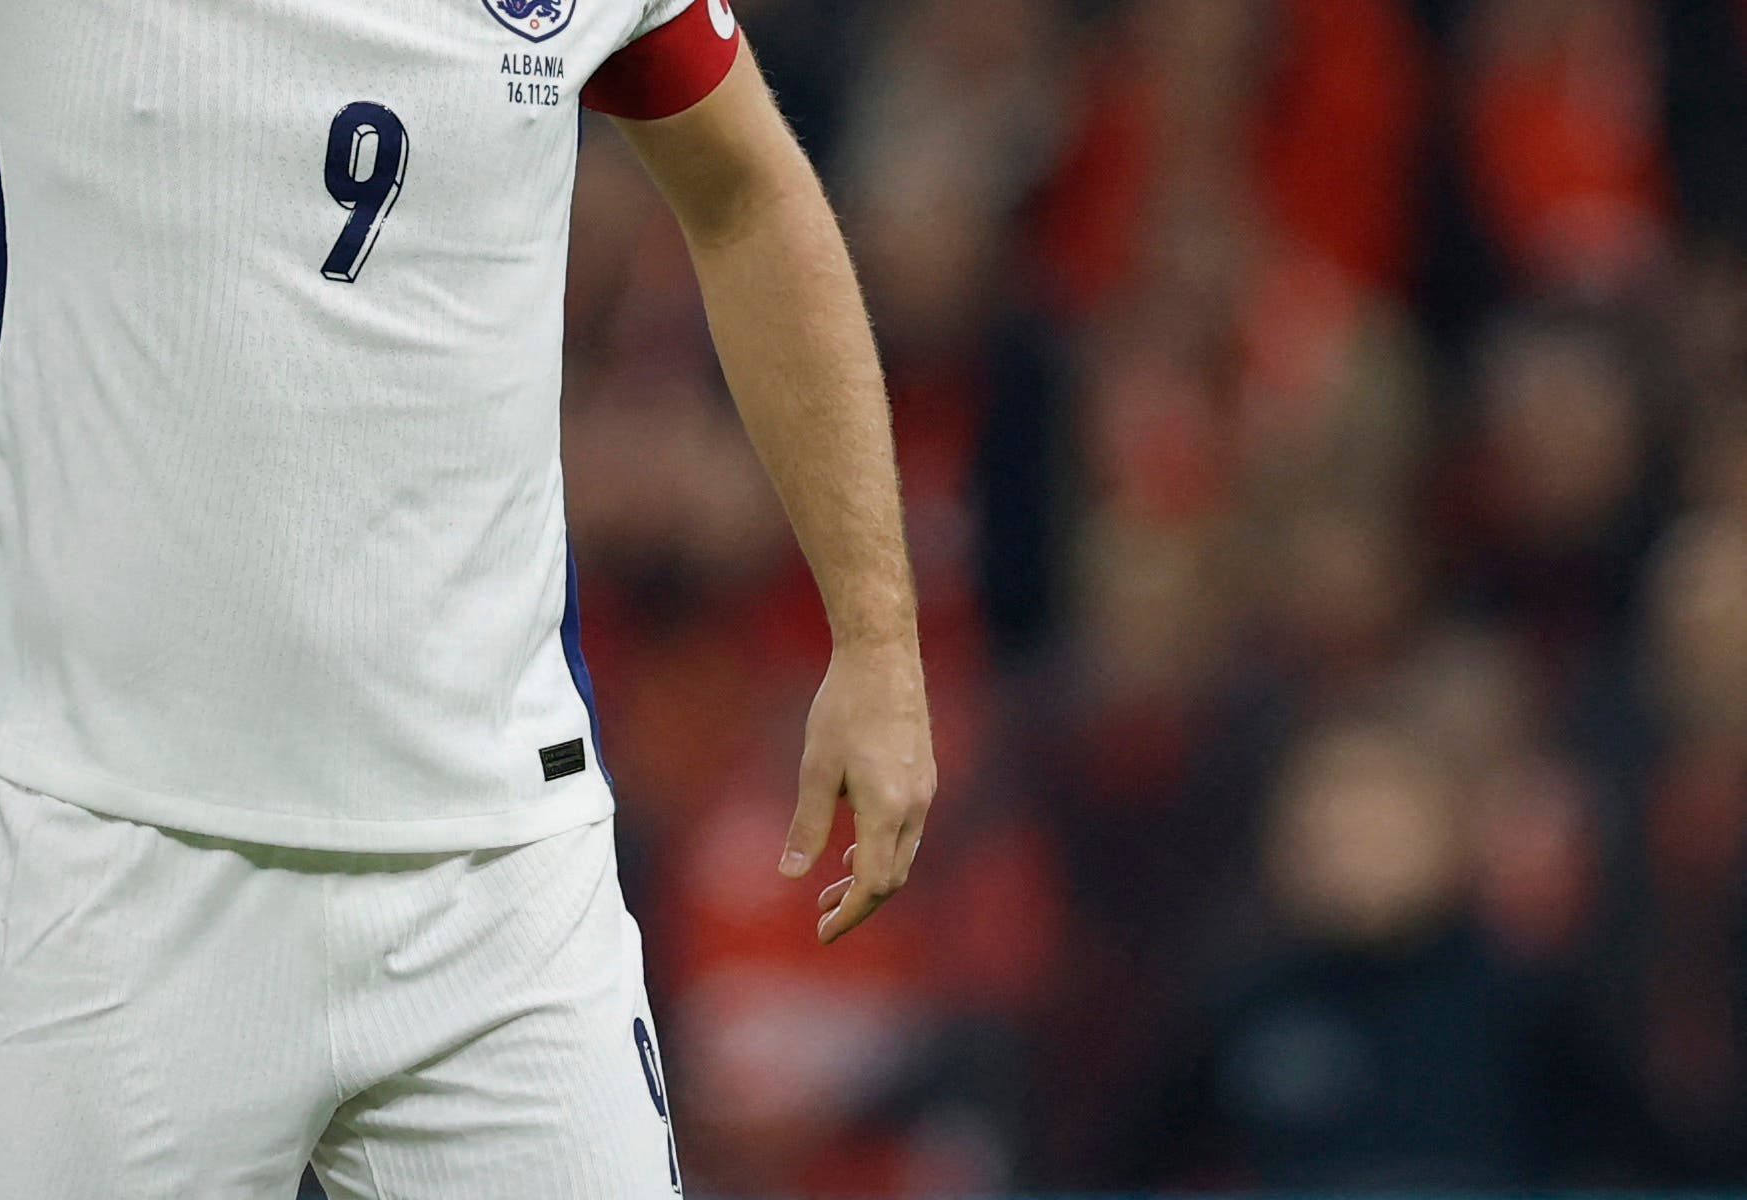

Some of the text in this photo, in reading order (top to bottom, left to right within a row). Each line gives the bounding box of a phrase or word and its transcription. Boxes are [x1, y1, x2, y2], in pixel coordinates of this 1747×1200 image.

[500, 53, 565, 79] ALBANIA
[507, 81, 559, 106] 16.11.25
[320, 100, 409, 284] 9
